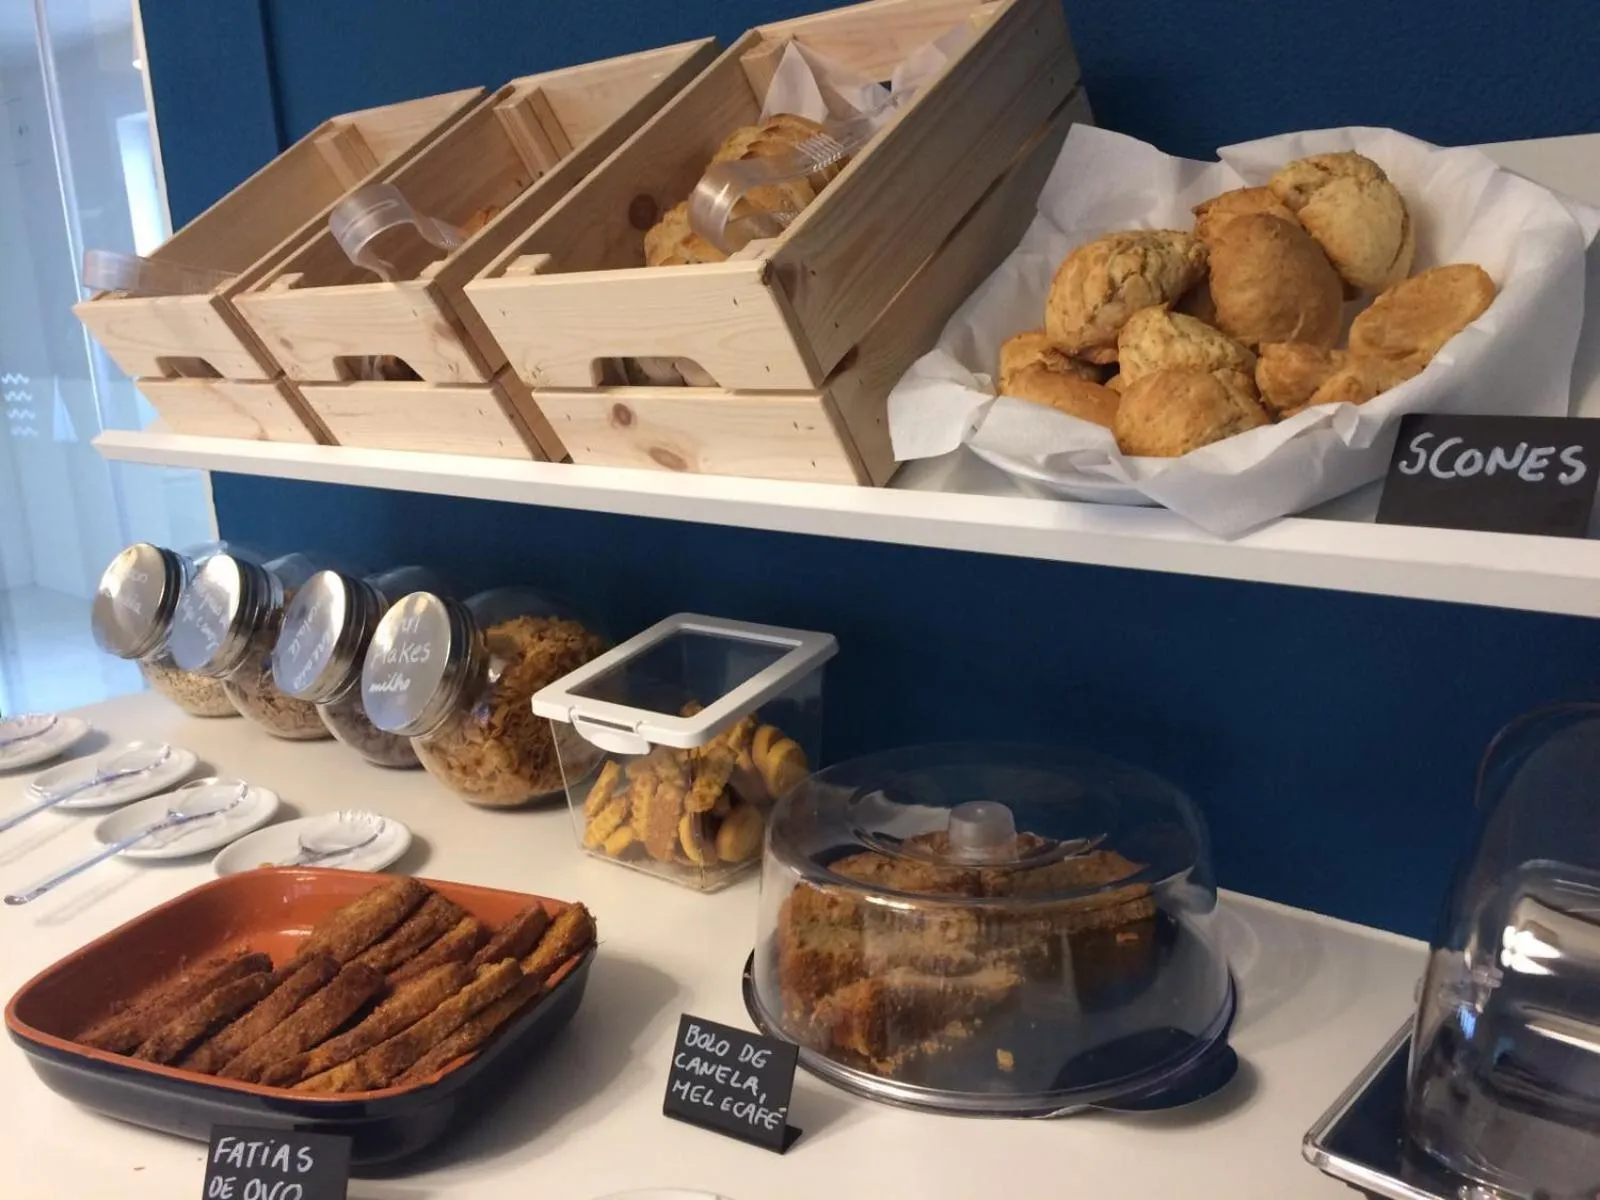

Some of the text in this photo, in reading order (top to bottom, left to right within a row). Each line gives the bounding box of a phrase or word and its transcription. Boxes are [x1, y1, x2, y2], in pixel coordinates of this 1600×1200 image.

[1399, 431, 1588, 486] SCONES
[684, 1024, 730, 1057] BOLO
[672, 1080, 714, 1107] MEL
[674, 1052, 767, 1104] CANELA,
[208, 1175, 303, 1200] DE OVO
